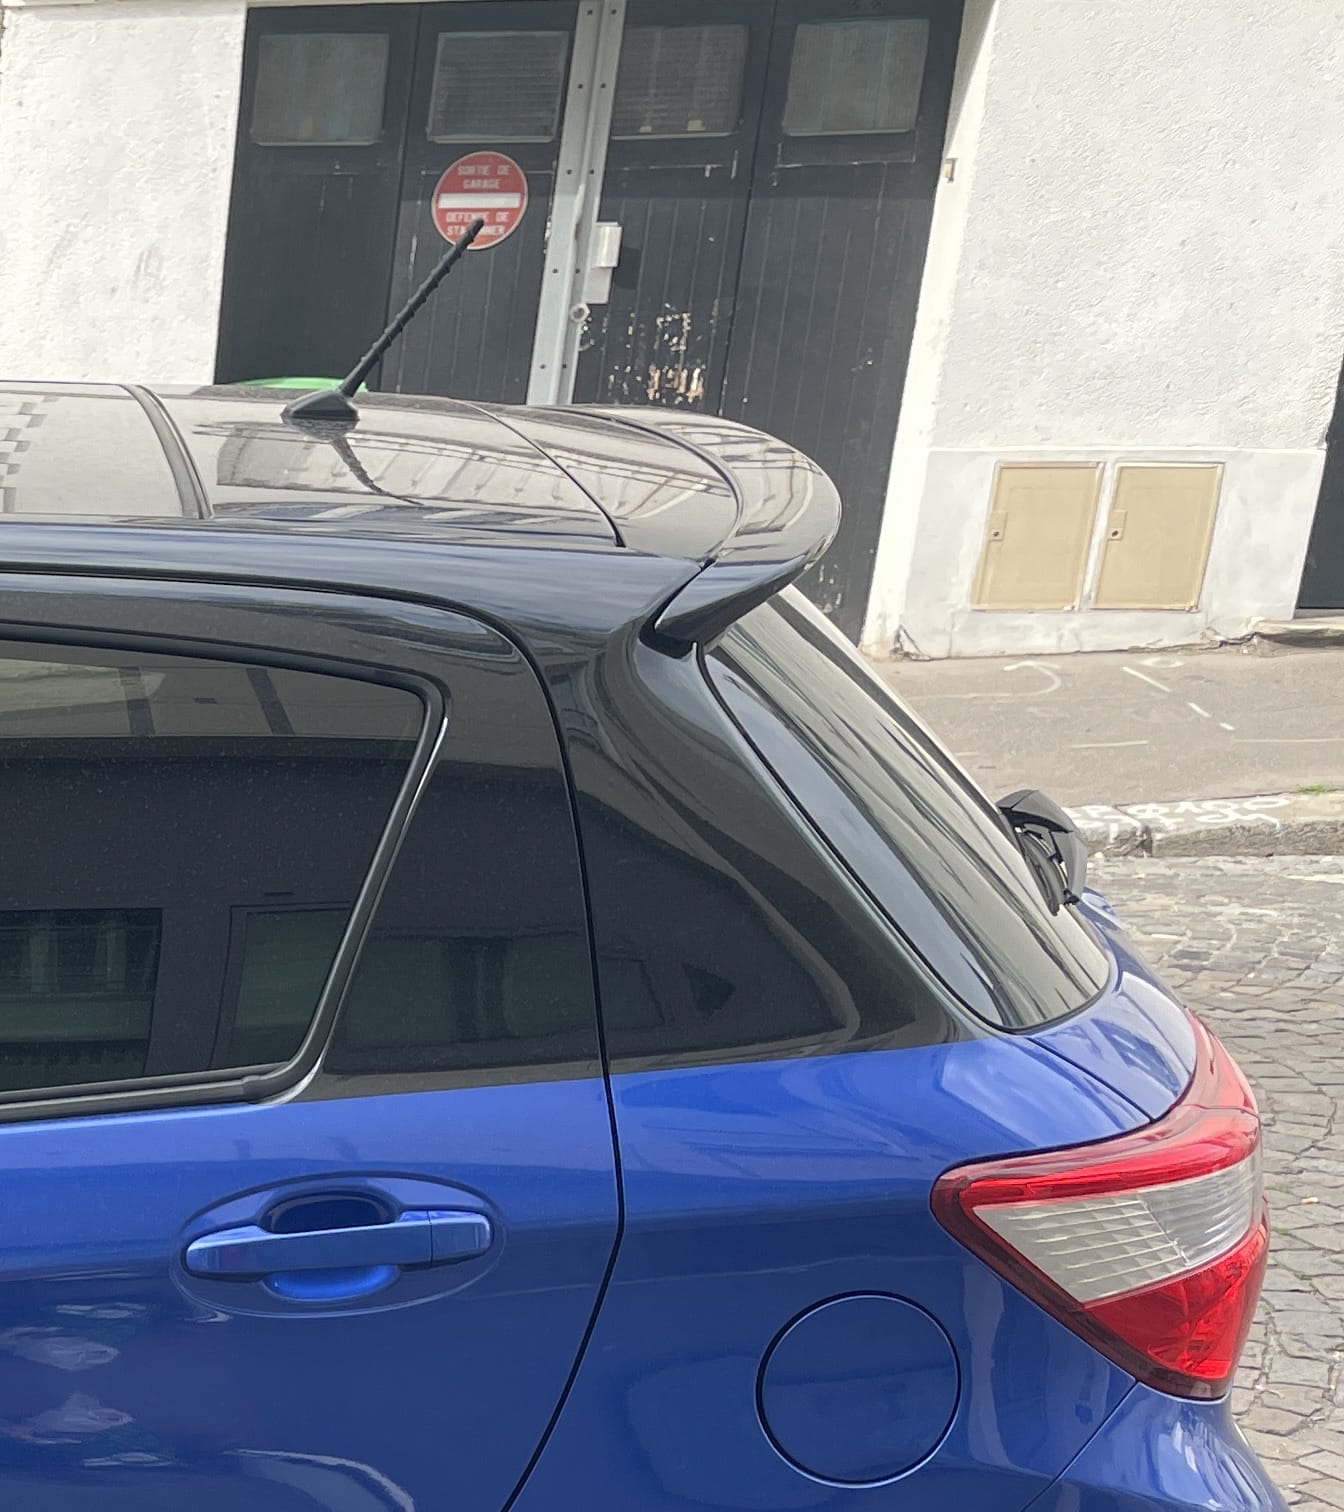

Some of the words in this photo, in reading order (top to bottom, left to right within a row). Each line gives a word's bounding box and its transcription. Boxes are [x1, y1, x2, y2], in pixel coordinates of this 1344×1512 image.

[457, 164, 491, 176] SORTIE
[497, 164, 510, 176] DE
[463, 178, 501, 189] GARAGE
[496, 211, 510, 223] DE
